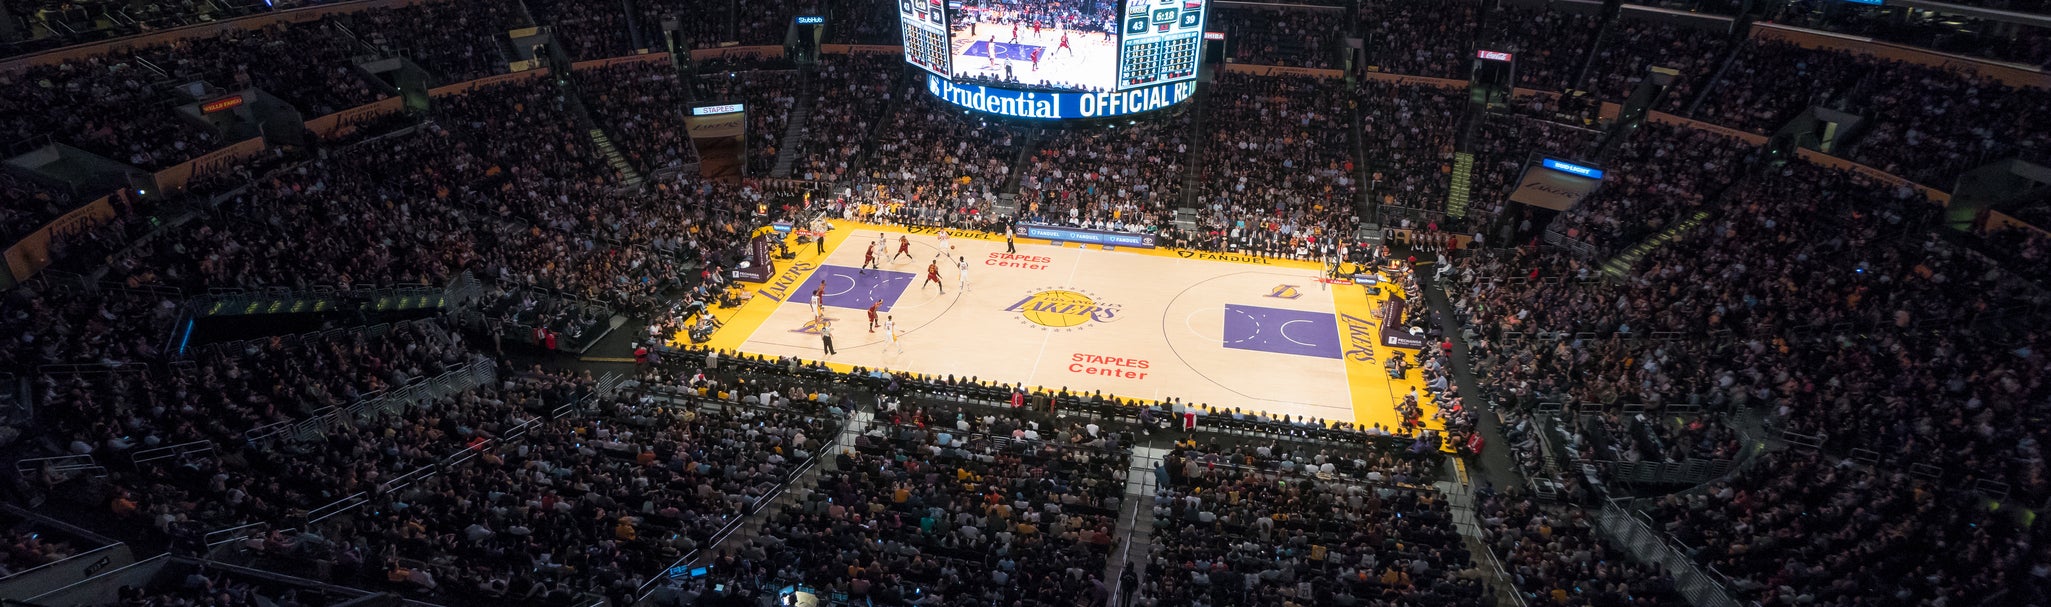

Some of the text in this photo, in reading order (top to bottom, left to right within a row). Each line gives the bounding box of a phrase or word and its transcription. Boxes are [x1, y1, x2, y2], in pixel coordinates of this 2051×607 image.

[798, 16, 823, 24] StubHub
[1156, 11, 1174, 21] 6:18
[1185, 15, 1195, 24] 39
[1132, 21, 1143, 31] 43
[943, 80, 1062, 118] Prudential
[1080, 85, 1169, 117] OFFICIAL
[985, 259, 1049, 271] Center
[989, 251, 1052, 264] STAPLES
[1199, 252, 1273, 265] FANDUEL
[758, 260, 818, 304] LAKERS
[1004, 295, 1124, 324] LAKERS
[1340, 311, 1377, 365] LAKERS
[1071, 352, 1150, 370] STAPLES
[1068, 363, 1149, 380] Center
